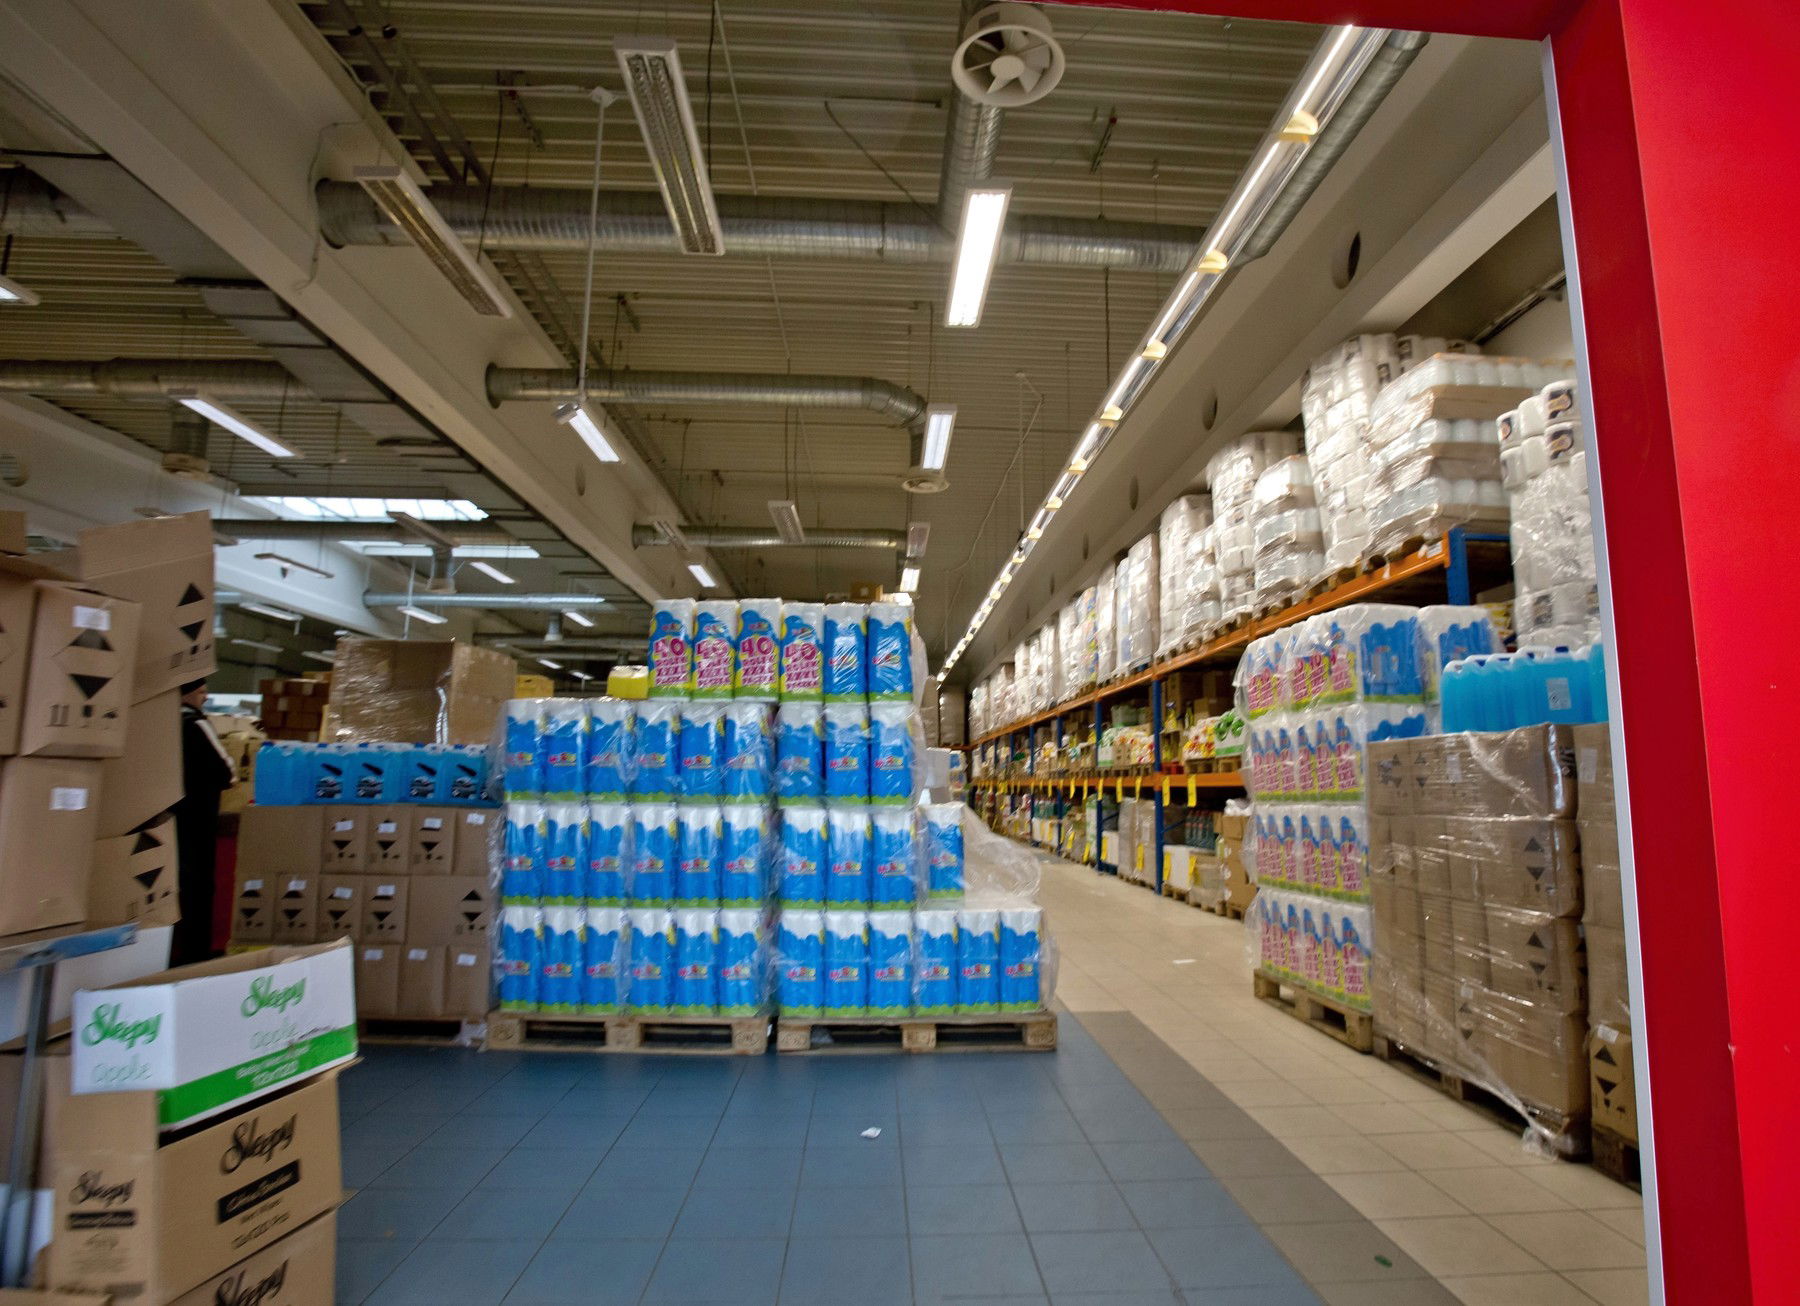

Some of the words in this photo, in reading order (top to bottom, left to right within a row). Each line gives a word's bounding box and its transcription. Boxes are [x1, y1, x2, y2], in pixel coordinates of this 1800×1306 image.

[740, 636, 774, 657] 40
[241, 974, 307, 1018] Sleepy
[81, 1002, 164, 1049] Sleepy
[220, 1112, 298, 1174] Sleepy
